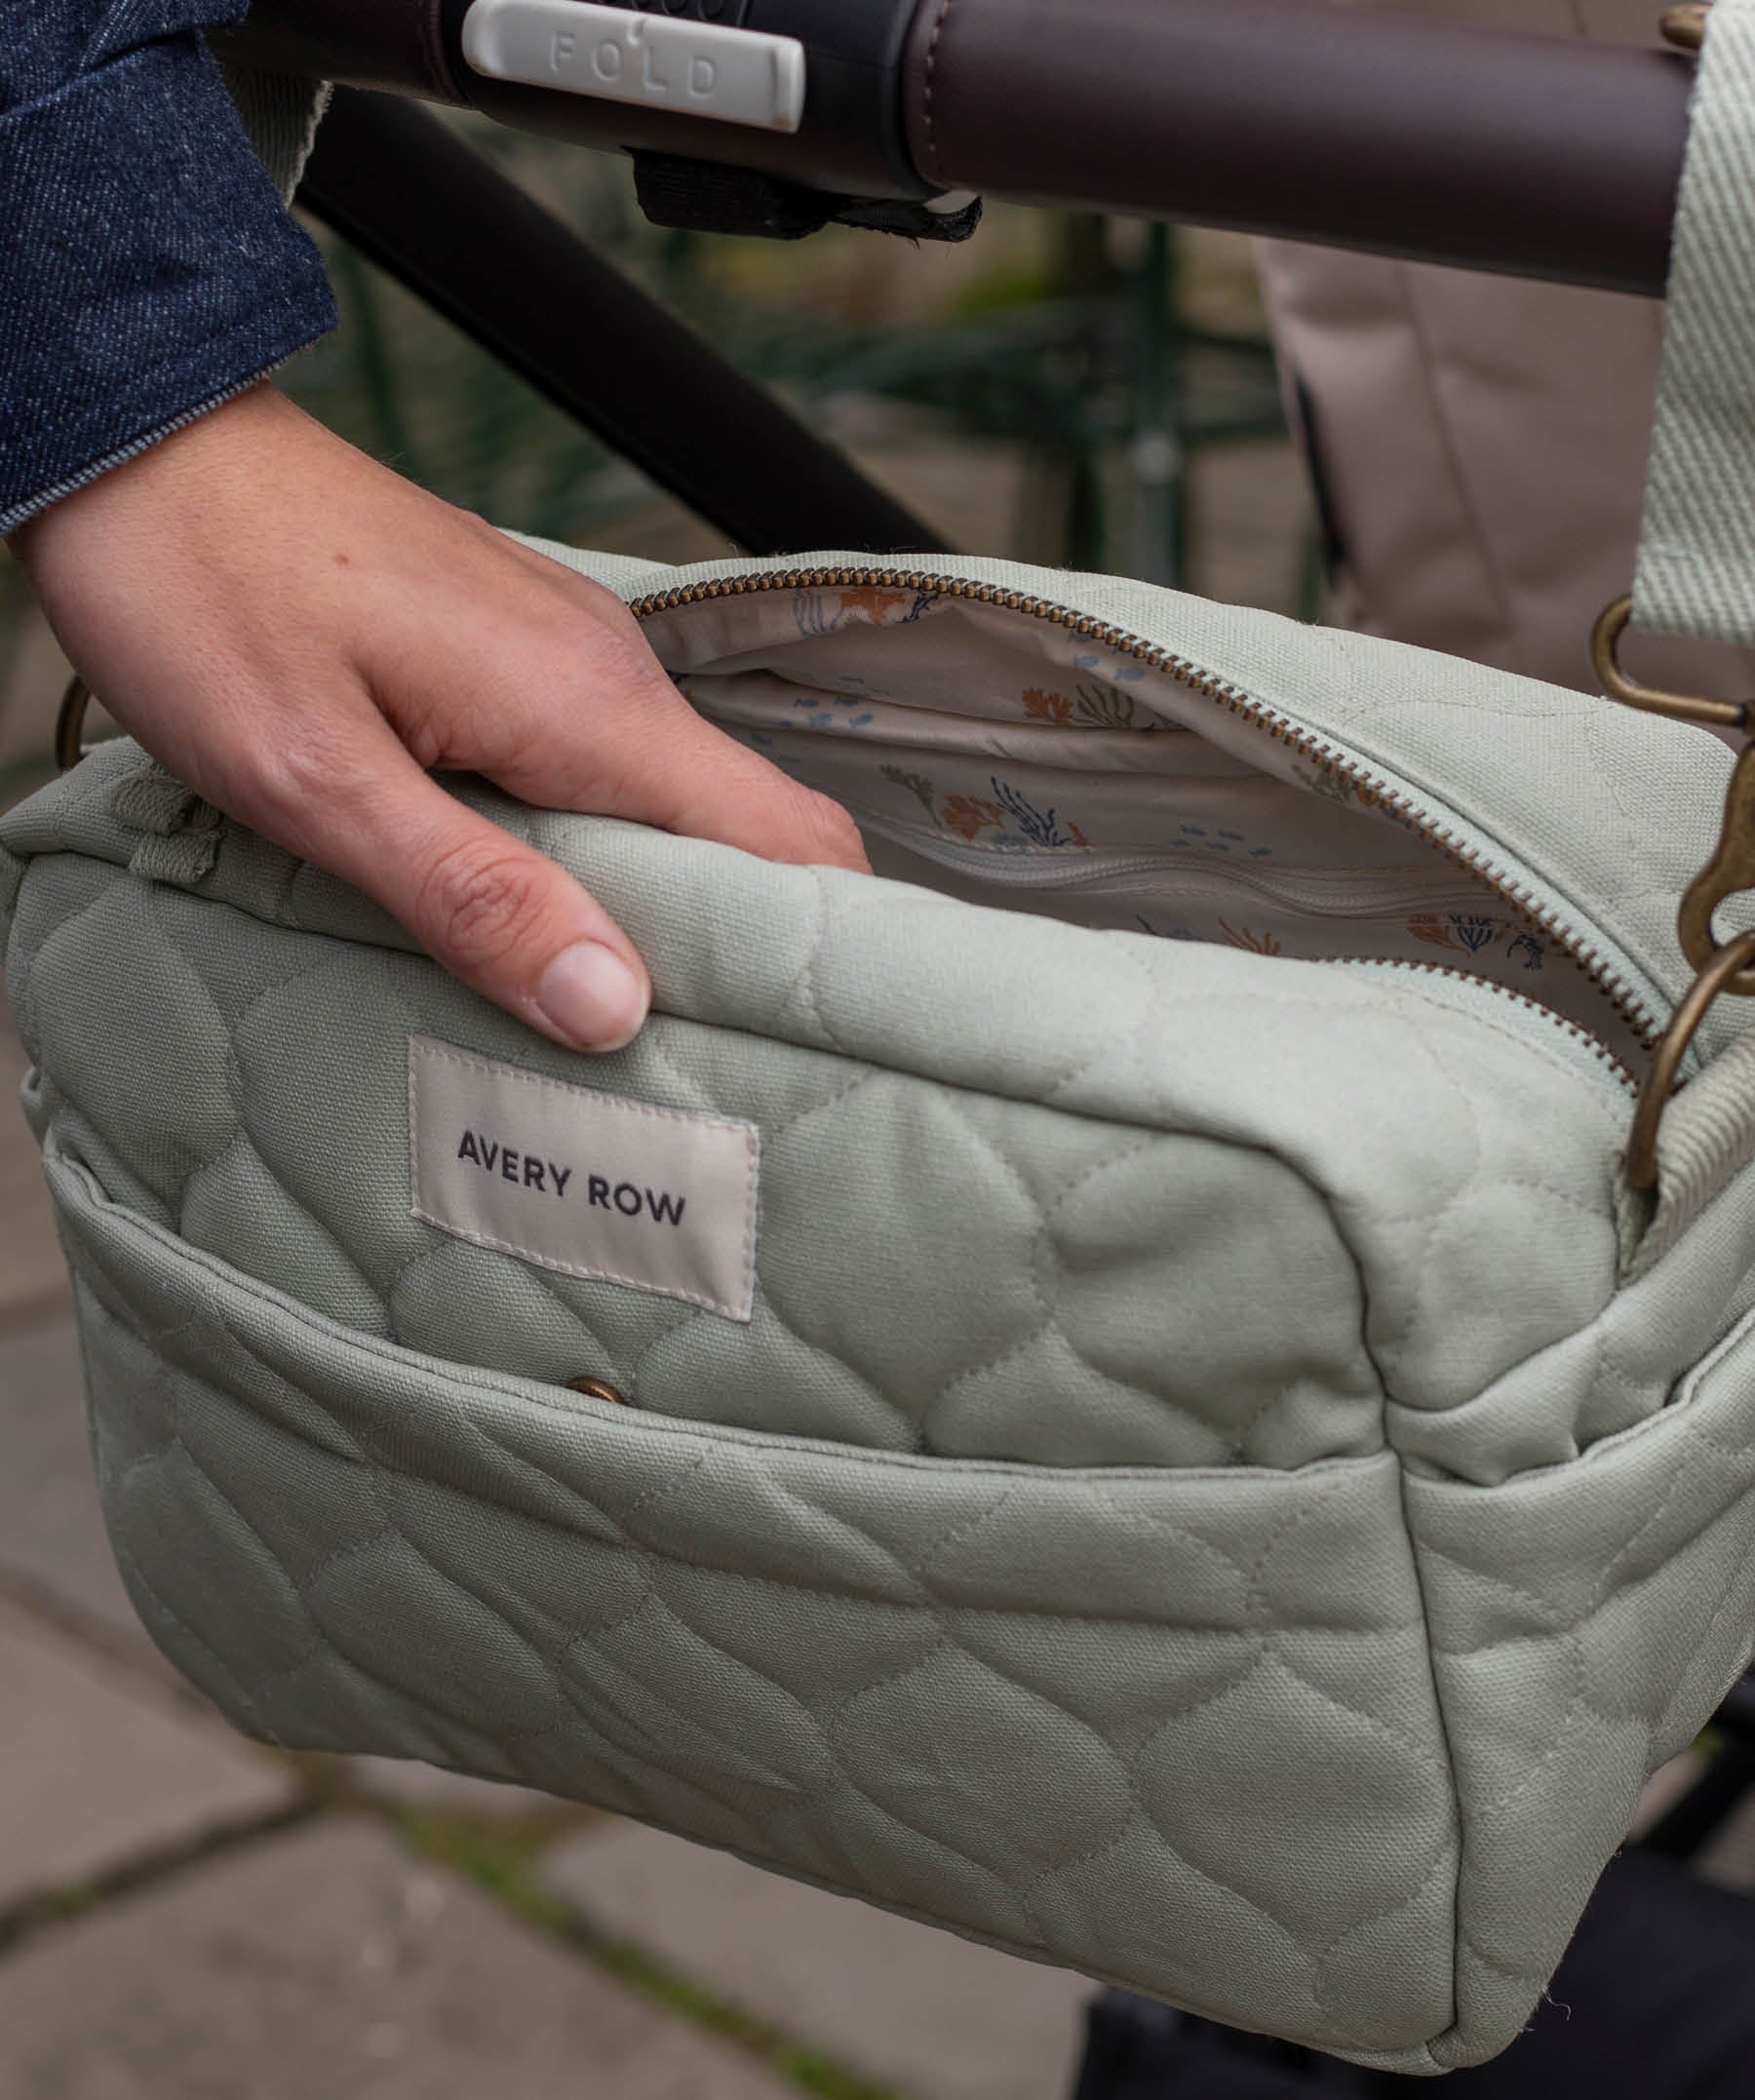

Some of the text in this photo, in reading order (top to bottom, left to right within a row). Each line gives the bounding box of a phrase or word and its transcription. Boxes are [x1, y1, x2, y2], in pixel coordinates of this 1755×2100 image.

[549, 29, 720, 97] FOLD
[457, 1130, 685, 1225] AVERY ROW
